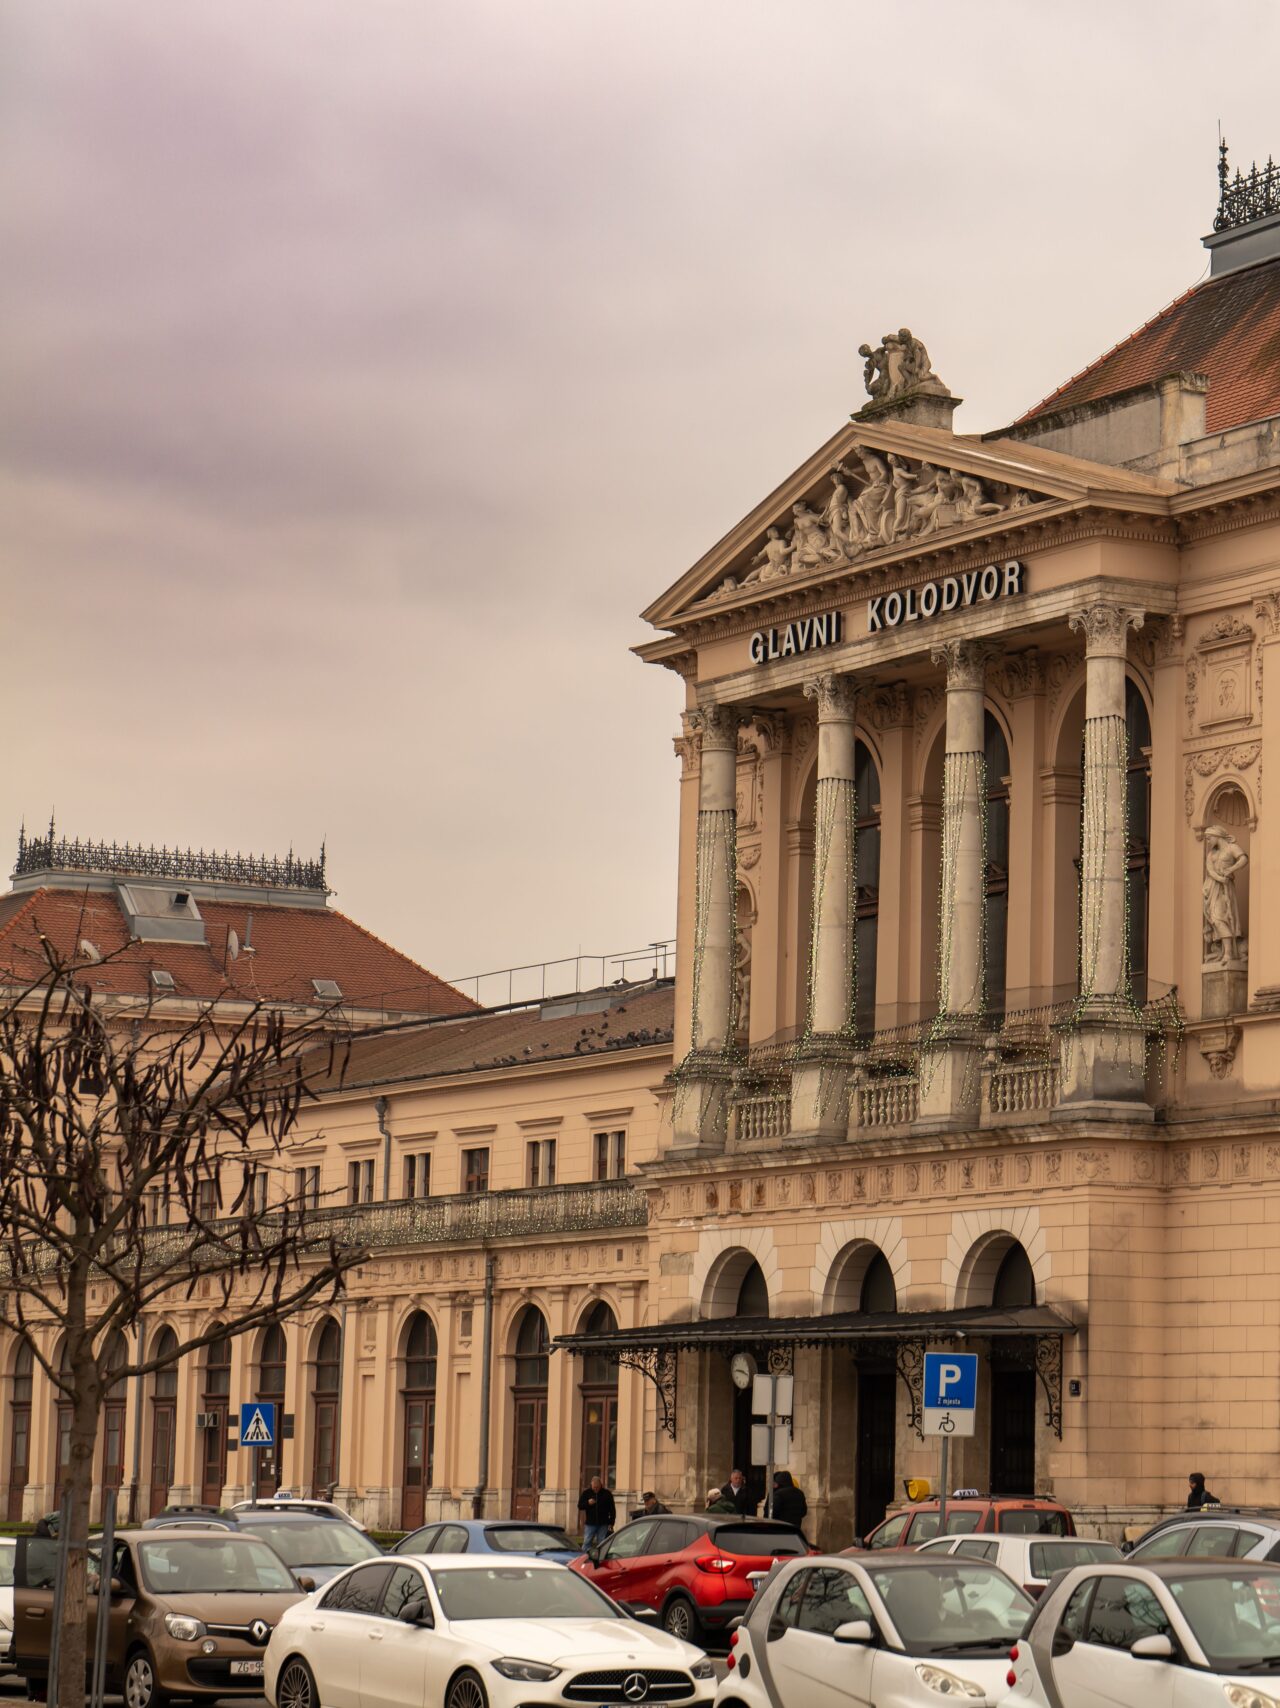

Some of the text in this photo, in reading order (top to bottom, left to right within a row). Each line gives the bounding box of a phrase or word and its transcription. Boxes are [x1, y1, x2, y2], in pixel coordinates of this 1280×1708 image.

[749, 560, 1023, 664] GLAVNI KOLODVOR
[939, 1364, 962, 1397] P
[237, 1662, 249, 1673] ZG
